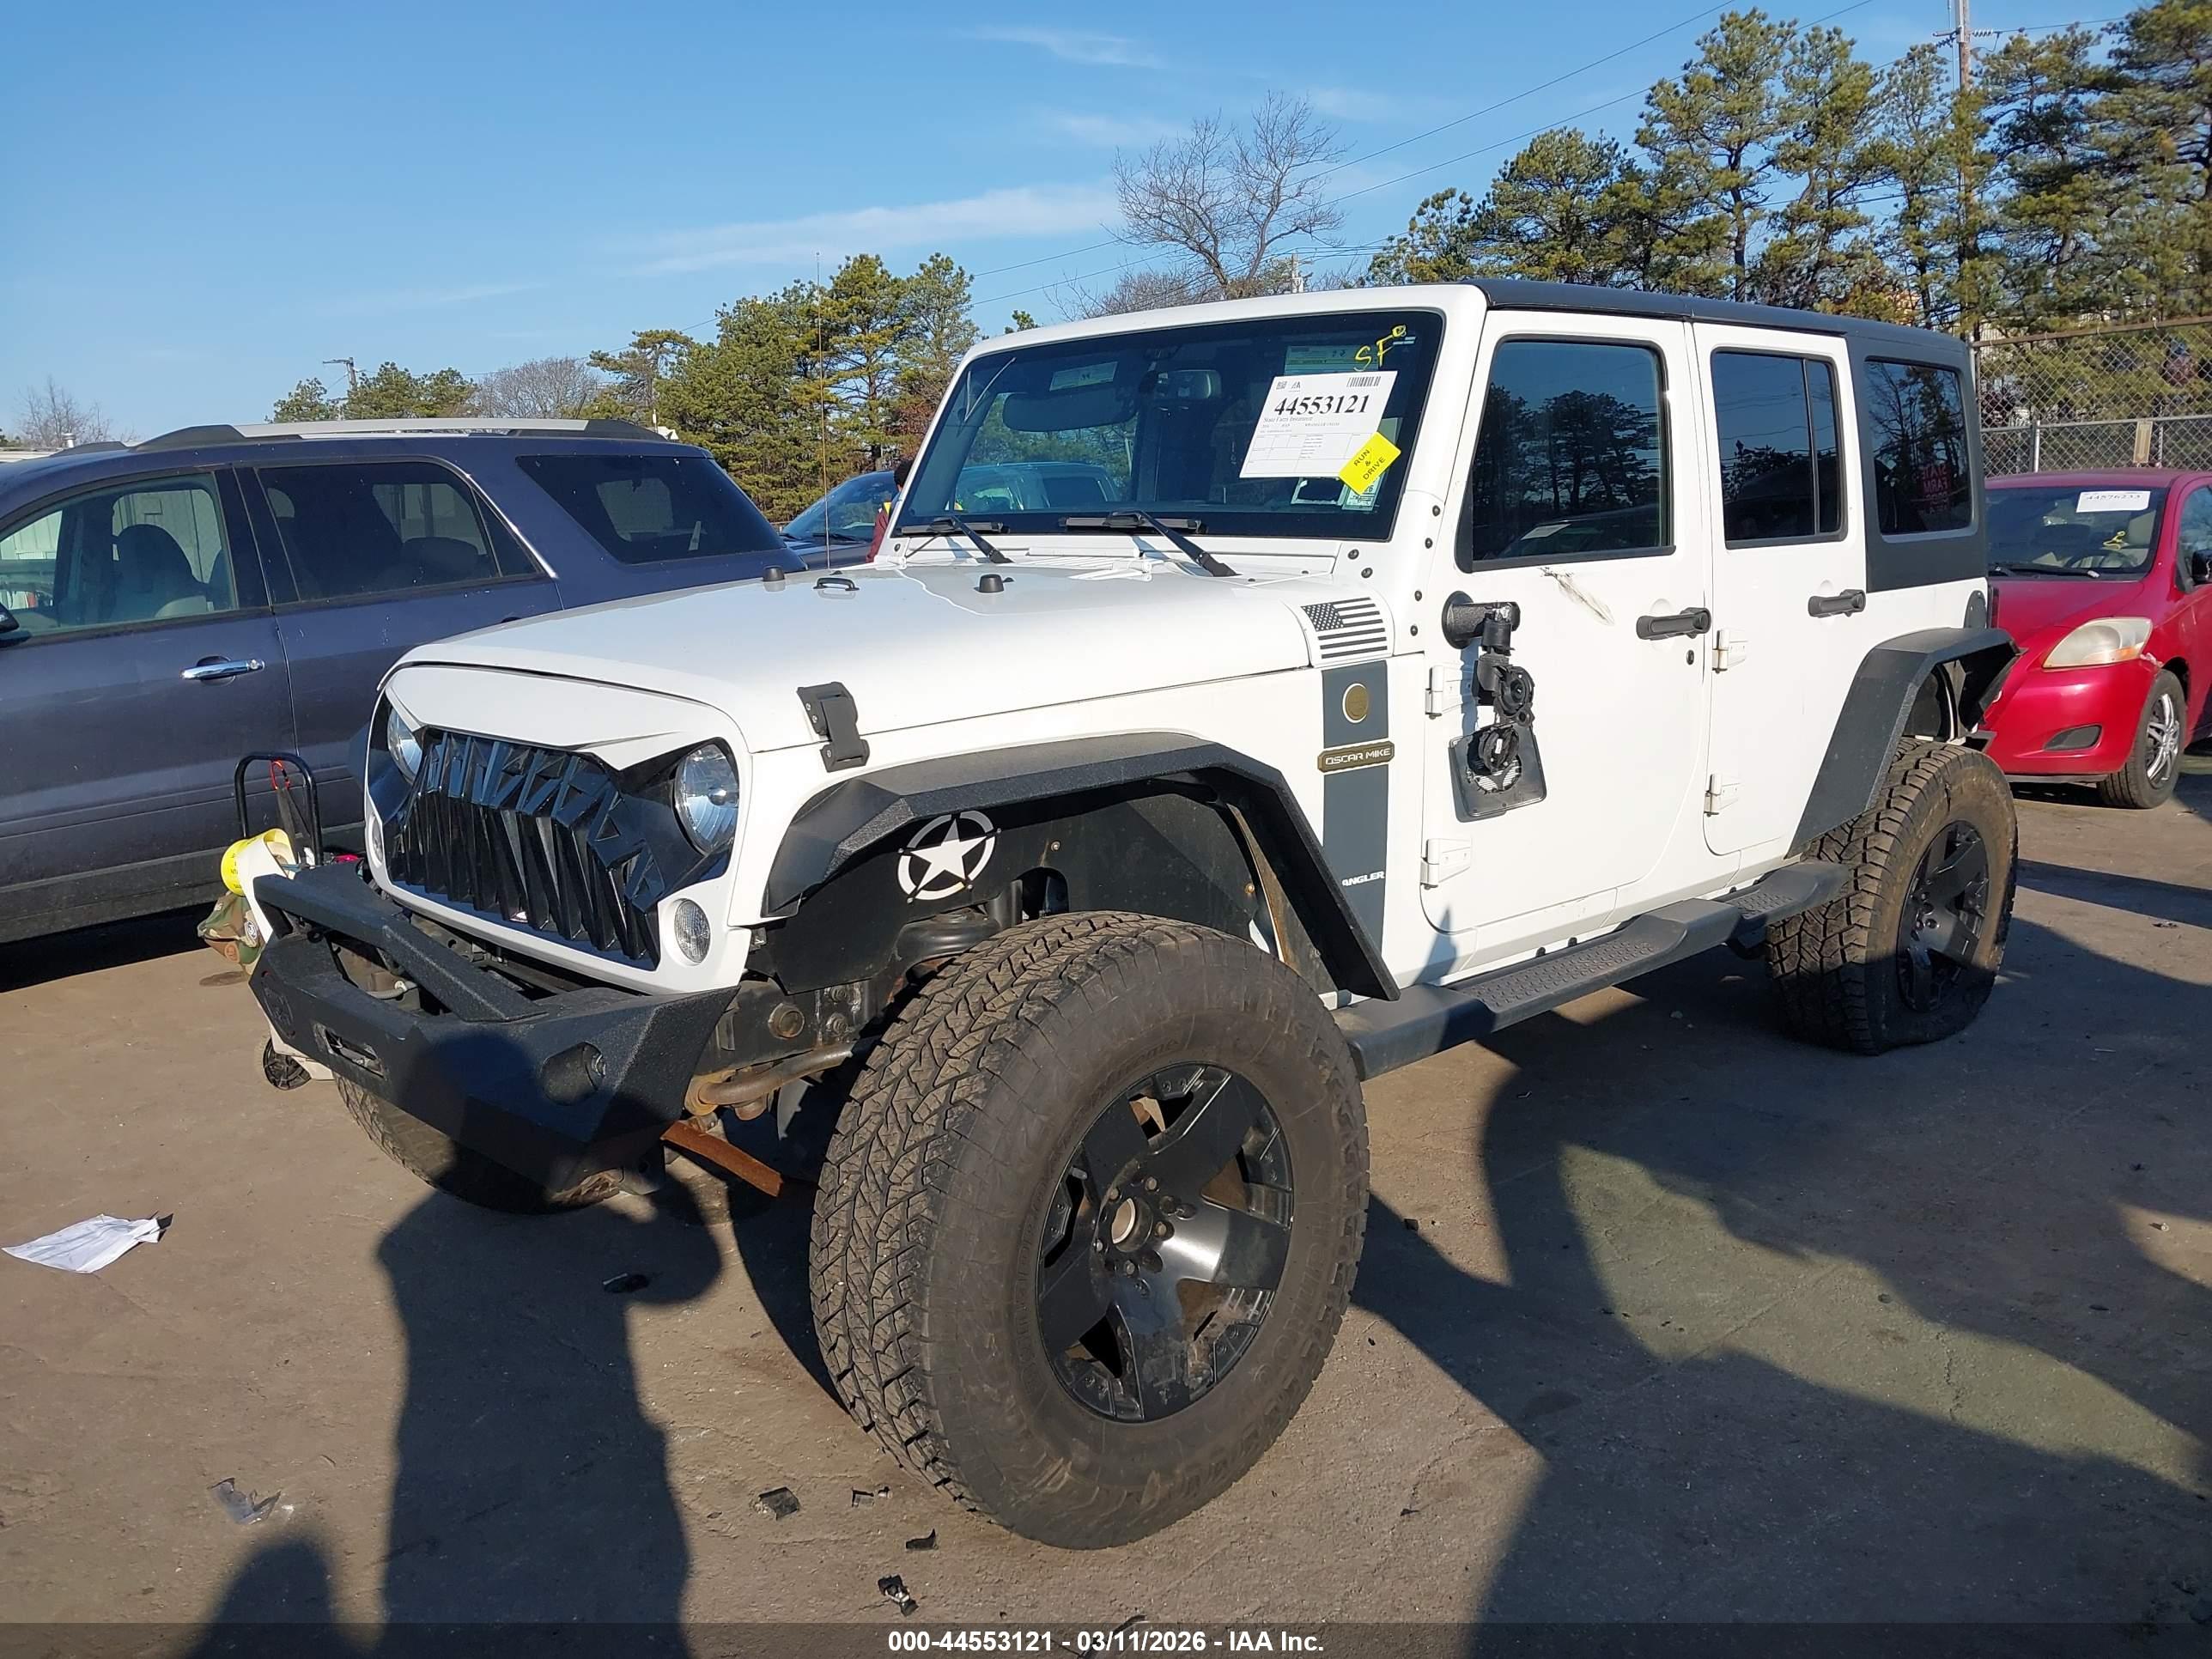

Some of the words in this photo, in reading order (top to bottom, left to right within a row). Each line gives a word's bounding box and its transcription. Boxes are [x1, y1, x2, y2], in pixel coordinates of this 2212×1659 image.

[1274, 394, 1370, 416] 44553121
[1353, 449, 1370, 466] RUN
[1363, 457, 1386, 480] DRIVE
[1325, 752, 1364, 765] OSCAR
[1365, 748, 1391, 759] MIKE
